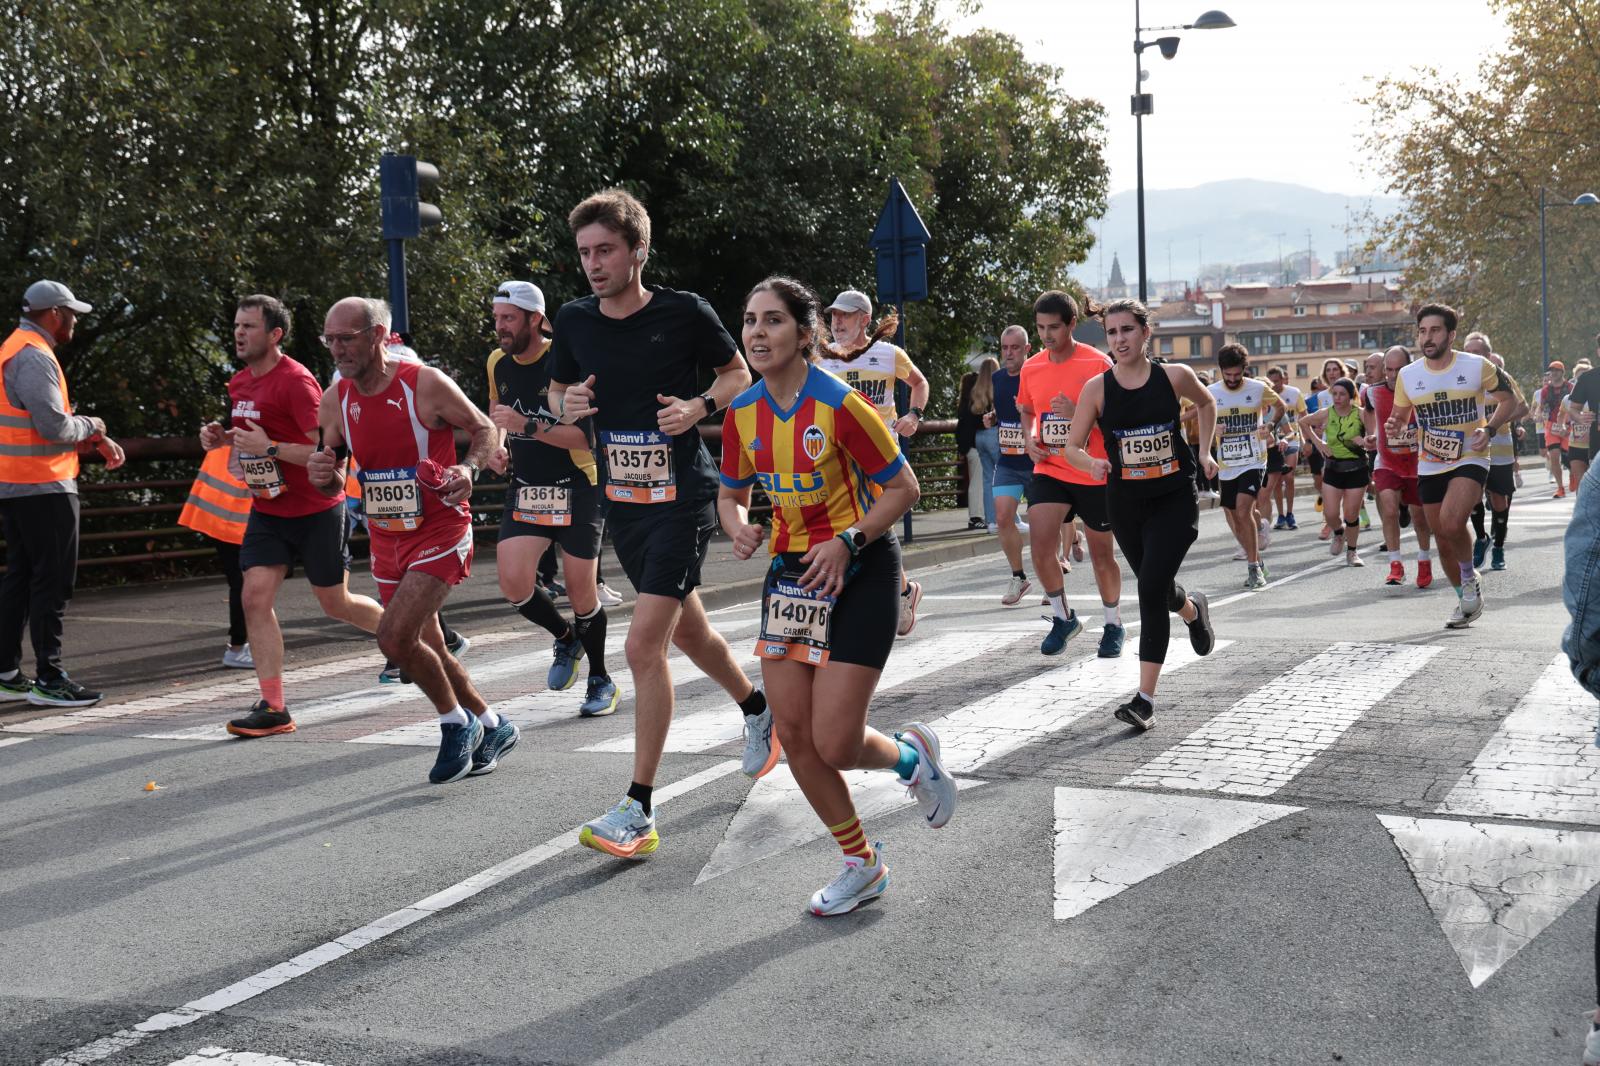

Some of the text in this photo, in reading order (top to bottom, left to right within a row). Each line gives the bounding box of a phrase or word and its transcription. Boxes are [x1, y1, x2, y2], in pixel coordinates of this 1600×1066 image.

[846, 371, 859, 381] 59
[609, 431, 644, 443] luanvi
[1000, 429, 1024, 439] 13371
[1123, 425, 1155, 437] luanvi
[1124, 434, 1170, 454] 15905
[1223, 442, 1248, 453] 30191
[1425, 434, 1459, 452] 15927
[610, 448, 667, 468] 13573
[364, 469, 396, 481] luanvi
[624, 472, 652, 480] JACQUES
[366, 483, 415, 503] 13603
[520, 487, 566, 501] 13613
[377, 505, 404, 513] AMANDIO
[771, 599, 827, 627] 14076
[783, 627, 813, 637] CARMEN
